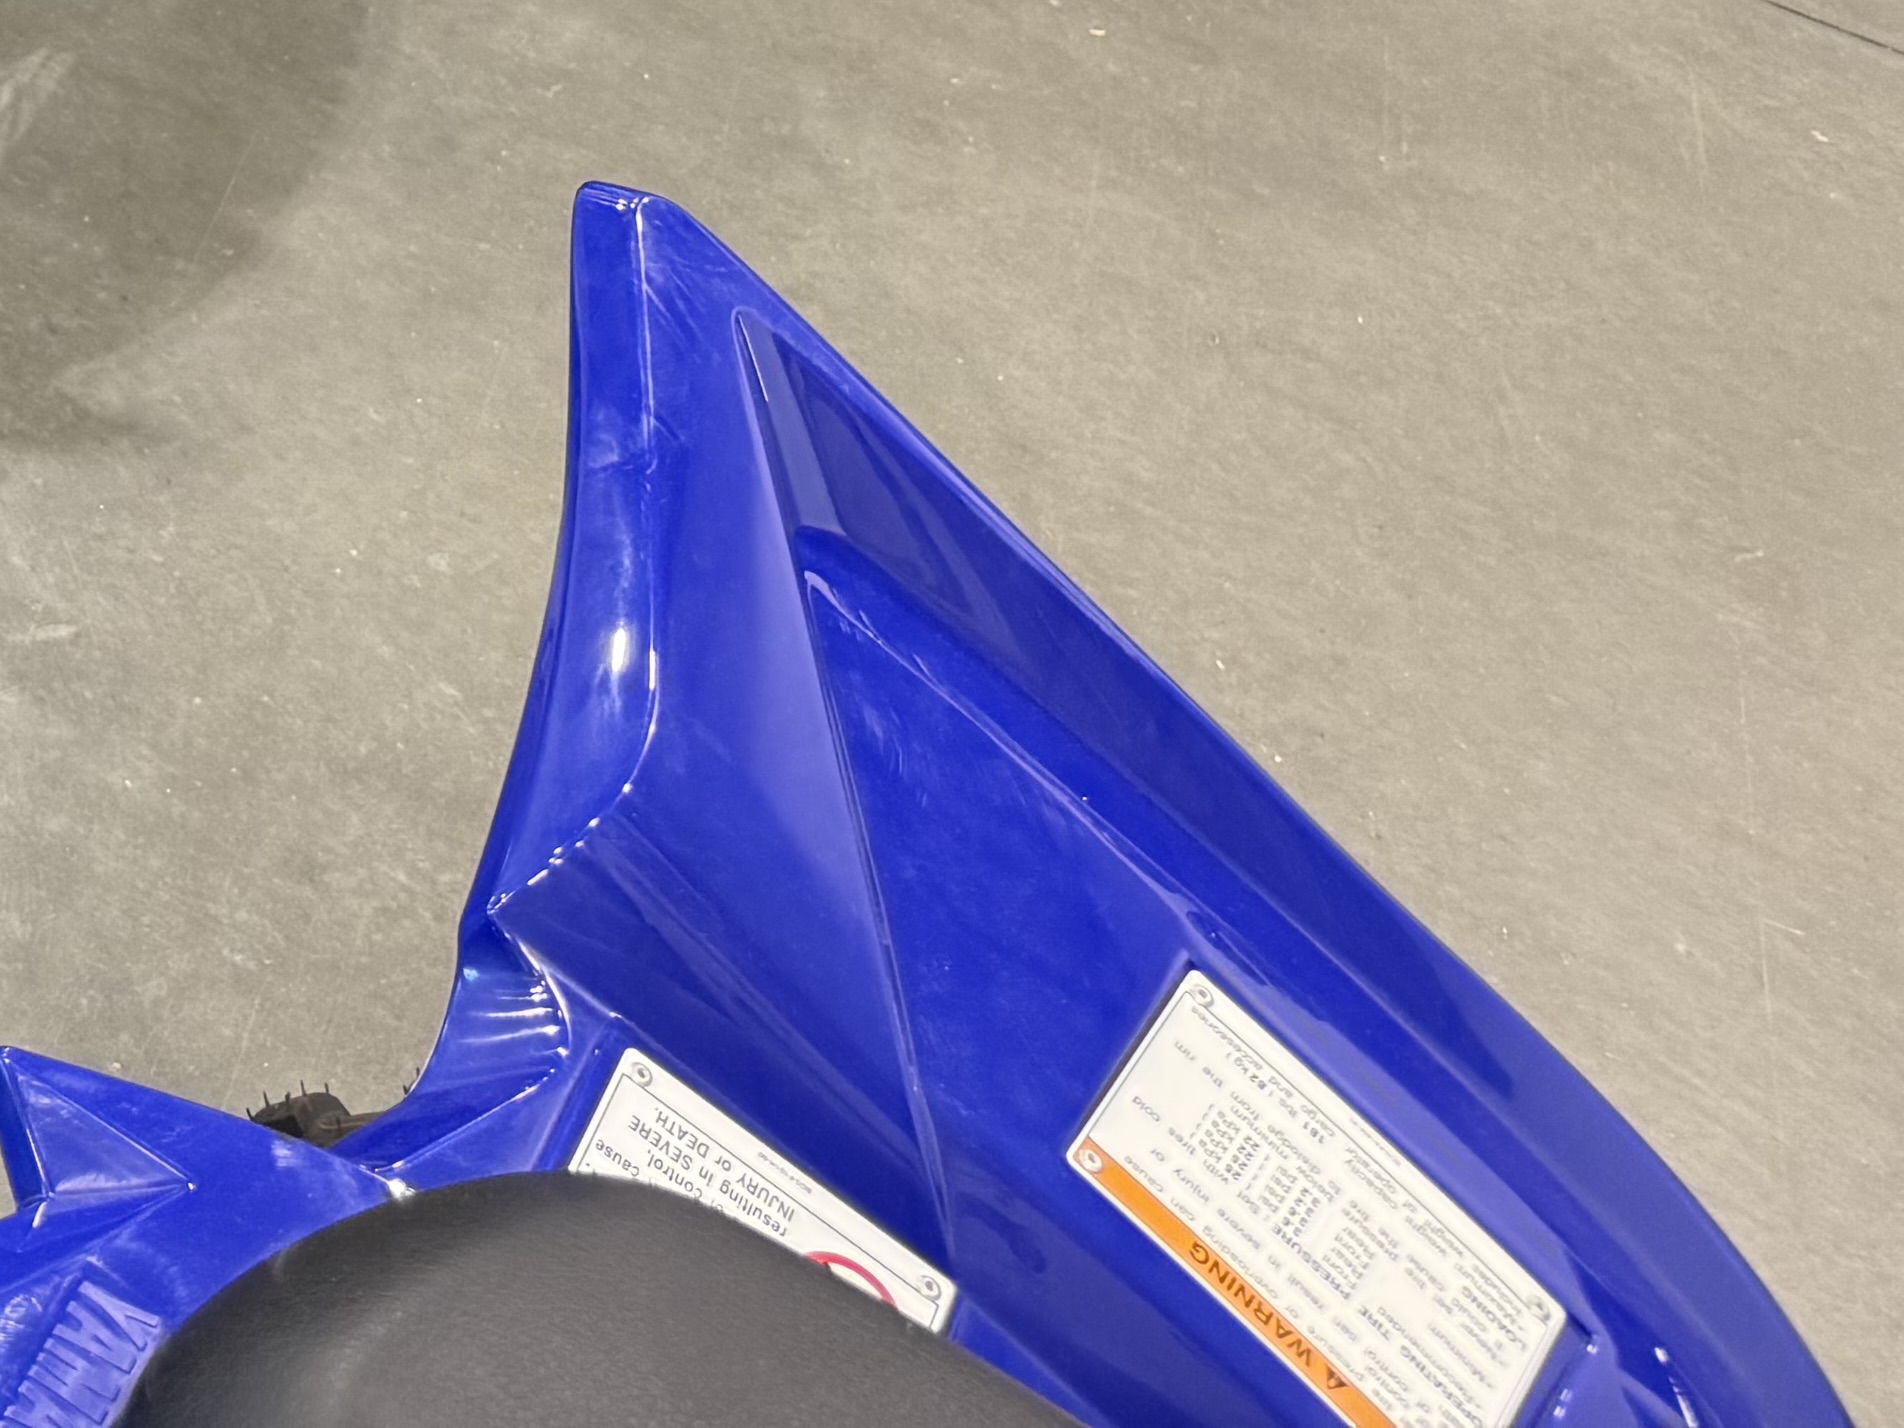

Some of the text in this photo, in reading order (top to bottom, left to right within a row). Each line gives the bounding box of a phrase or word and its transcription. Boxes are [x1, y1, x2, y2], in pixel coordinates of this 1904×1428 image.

[1131, 1094, 1161, 1124] cold
[1228, 1089, 1260, 1122] from
[626, 1113, 693, 1171] SEVERE
[649, 1105, 710, 1159] DEATH.
[1166, 1126, 1196, 1156] tires
[1265, 1121, 1322, 1177] dislodge
[594, 1137, 640, 1178] cause
[642, 1148, 704, 1203] control,
[696, 1165, 714, 1186] in
[713, 1153, 733, 1173] or
[1122, 1153, 1165, 1195] cause
[1201, 1158, 1229, 1187] with
[717, 1177, 789, 1240] resulting
[735, 1170, 795, 1222] INJURY
[1171, 1165, 1210, 1205] injury
[1168, 1196, 1196, 1224] can
[1200, 1224, 1280, 1302] overloading
[1270, 1222, 1352, 1301] PRESSURE
[1185, 1239, 1317, 1367] WARNING
[1356, 1304, 1391, 1340] TIRE
[1458, 1284, 1528, 1352] LOADING
[1396, 1344, 1484, 1428] OPERATING
